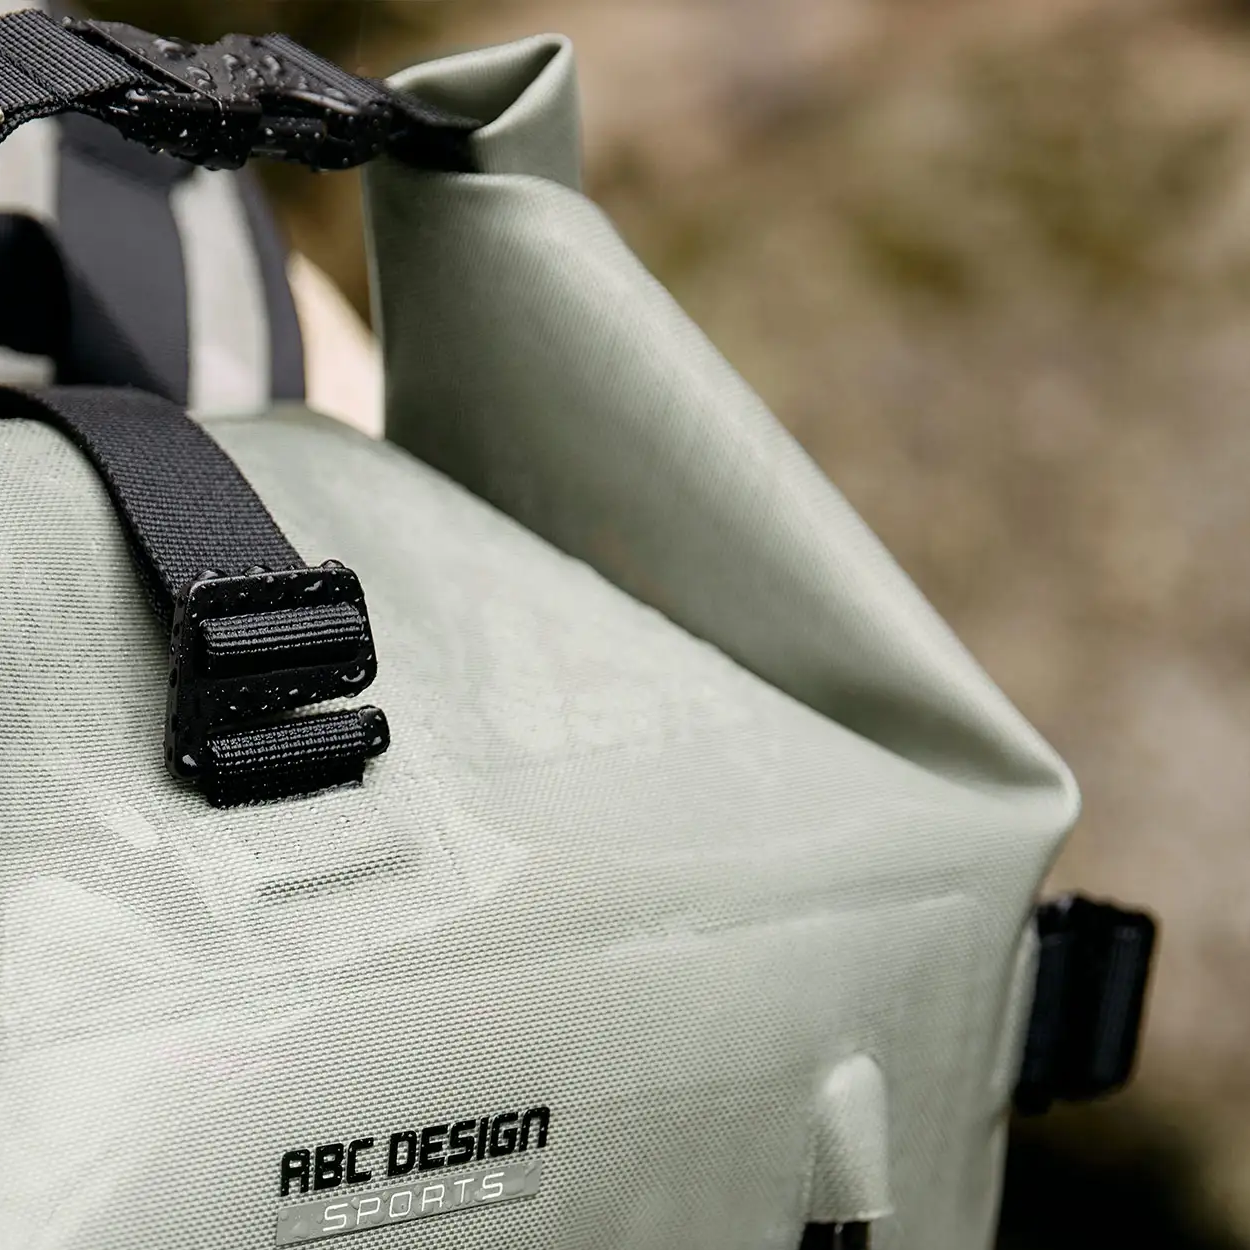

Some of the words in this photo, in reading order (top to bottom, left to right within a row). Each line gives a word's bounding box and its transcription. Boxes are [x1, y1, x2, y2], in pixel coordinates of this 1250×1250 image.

[280, 1137, 374, 1197] ABC
[387, 1106, 550, 1177] DESIGN
[322, 1172, 505, 1232] SPORTS
